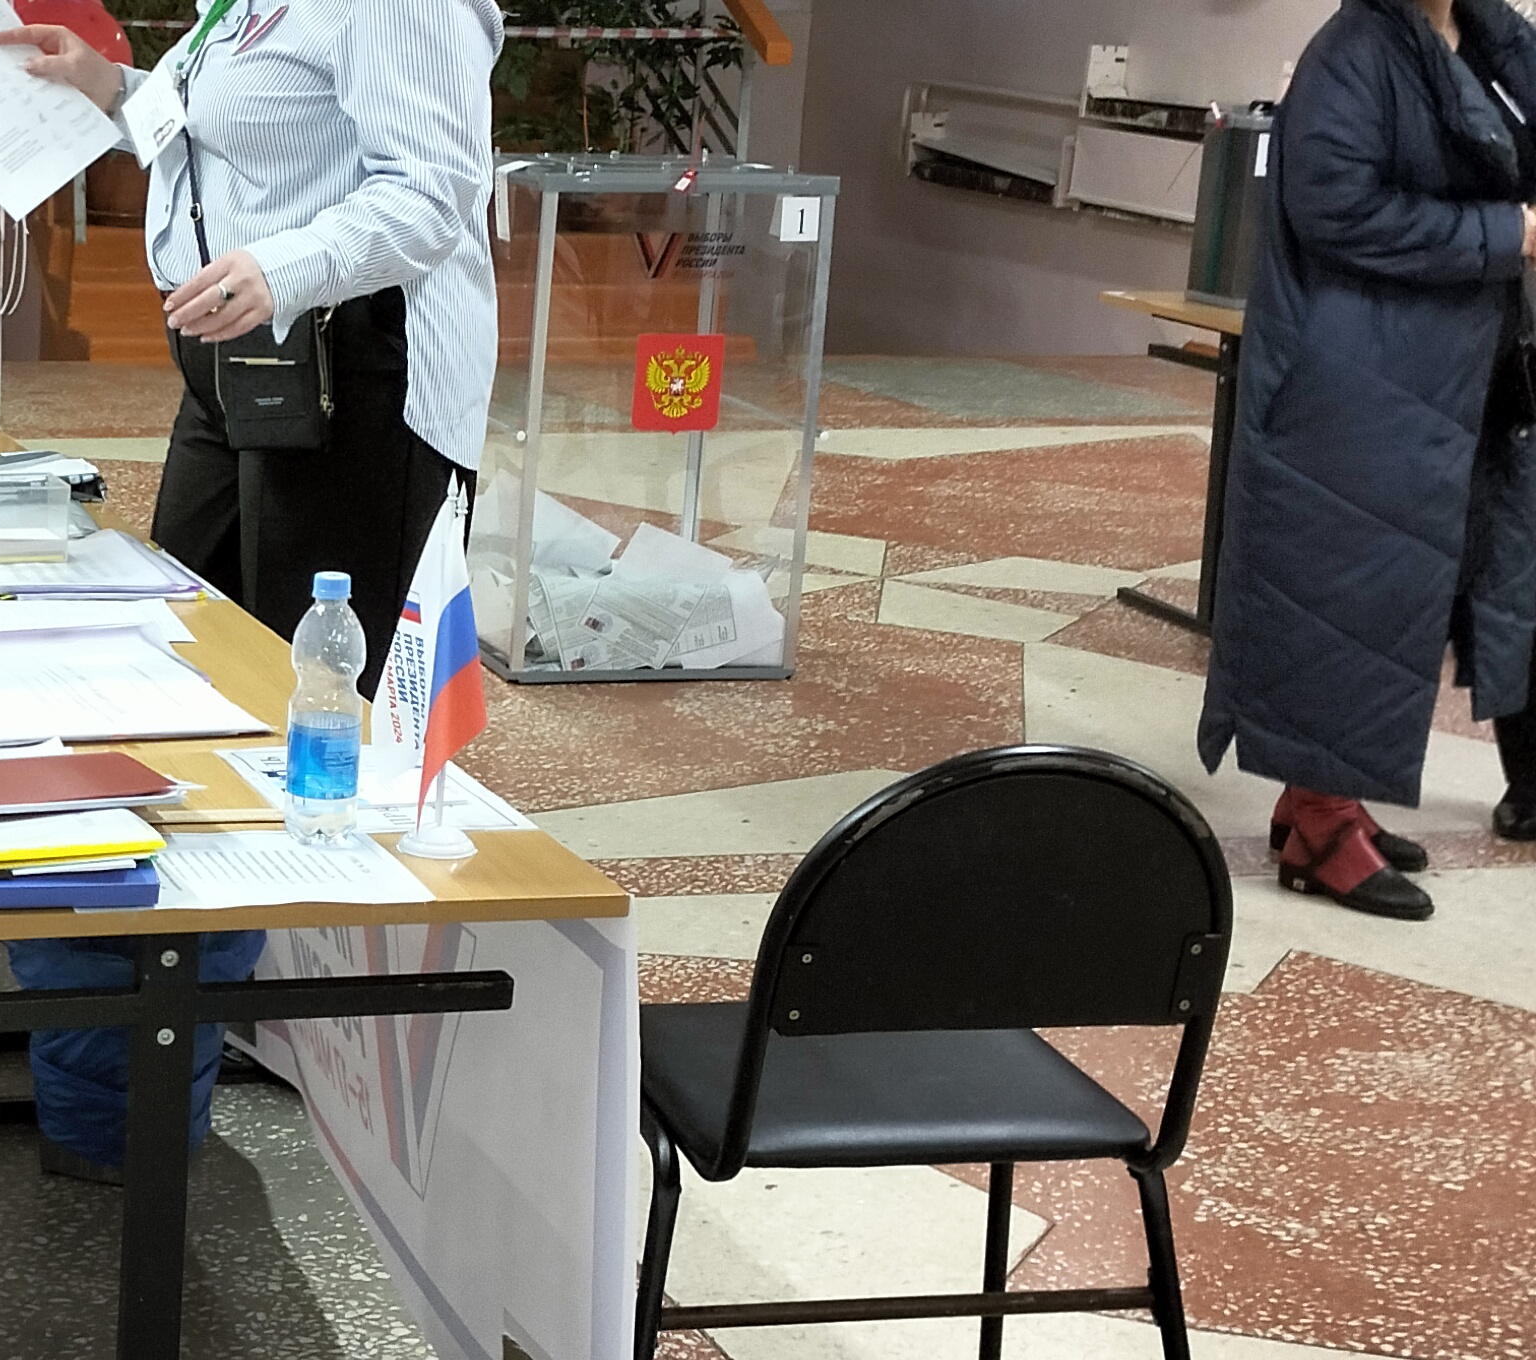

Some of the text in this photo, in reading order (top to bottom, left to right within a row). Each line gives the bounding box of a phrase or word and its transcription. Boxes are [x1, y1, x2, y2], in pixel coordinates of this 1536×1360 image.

[798, 208, 805, 235] 1
[687, 232, 734, 243] ВЫБОРЫ
[681, 245, 746, 256] ПРЕЗИДЕНТА
[675, 258, 718, 268] РОССИИ
[403, 632, 420, 750] ПРЕЗИДЕНТА
[390, 712, 403, 744] 2024
